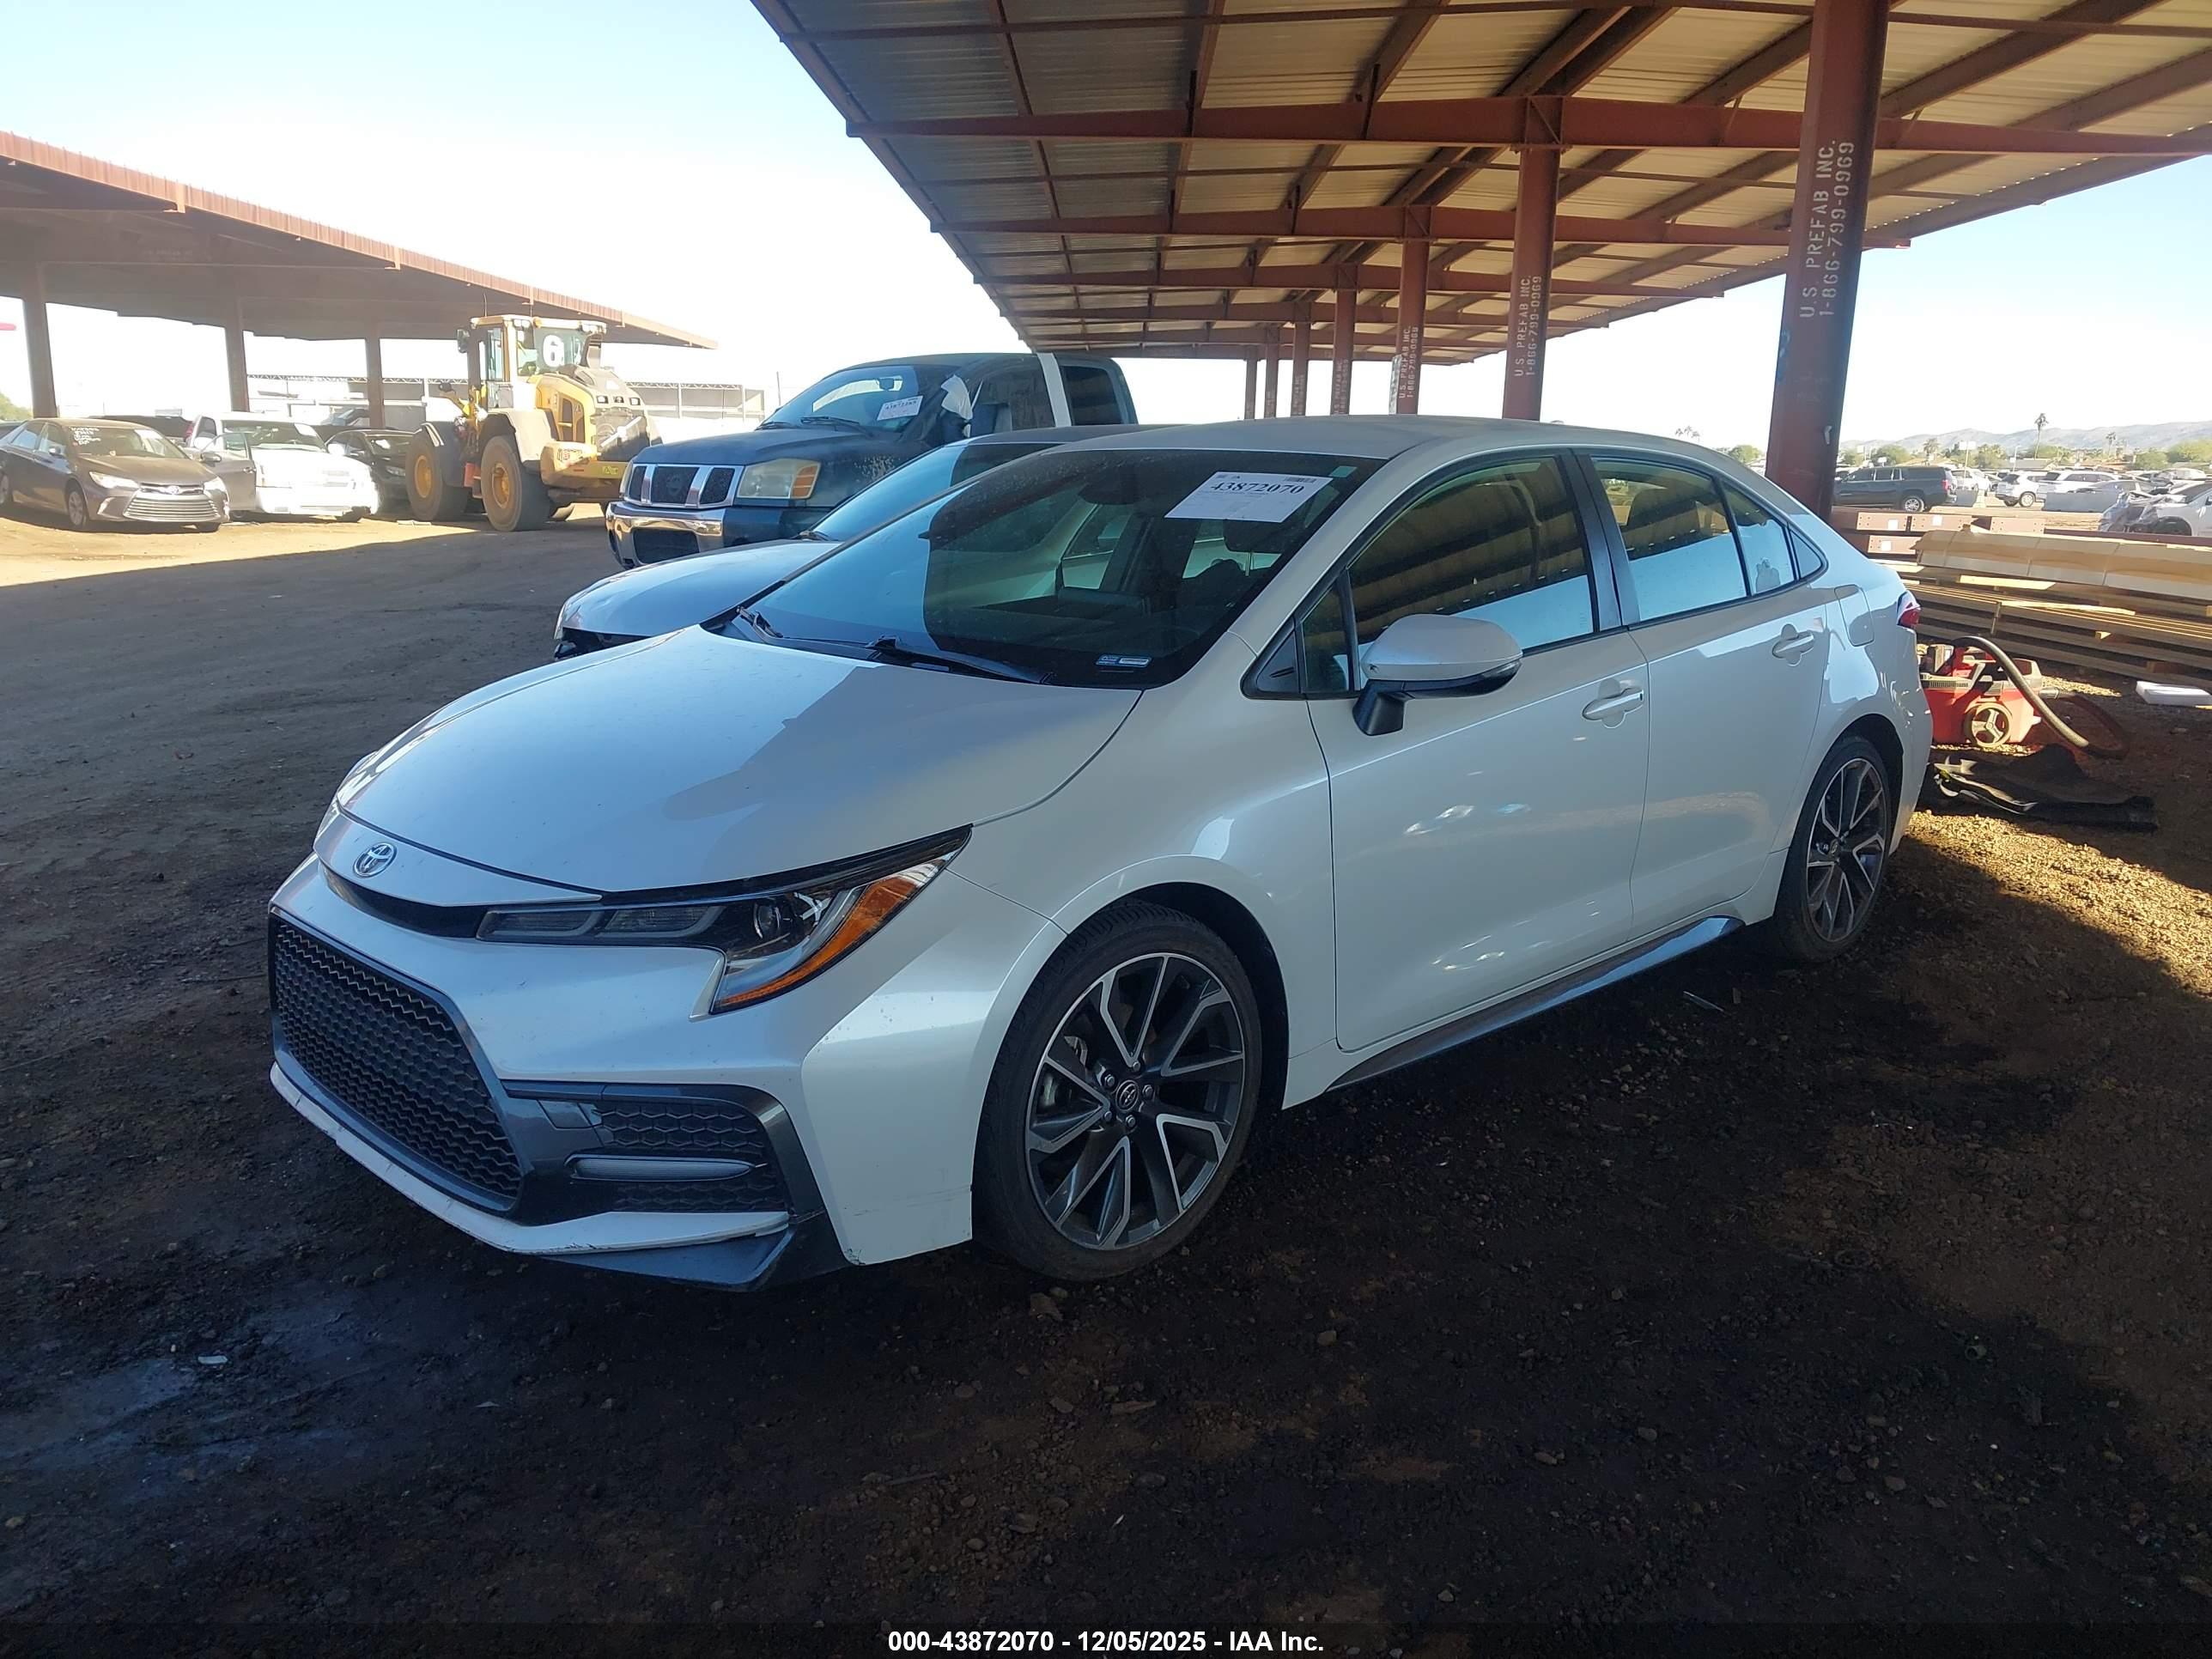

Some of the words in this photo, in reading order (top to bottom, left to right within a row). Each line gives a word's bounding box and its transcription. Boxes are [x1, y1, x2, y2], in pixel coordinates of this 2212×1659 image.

[1815, 140, 1836, 179] INC.
[1806, 190, 1829, 268] PREFAB
[1819, 142, 1855, 316] 1-866-799-0969
[1520, 275, 1531, 297] INC.
[1516, 303, 1528, 348] PREFAB
[1525, 276, 1542, 375] 1-866-799-0969
[1211, 482, 1304, 494] 43872070
